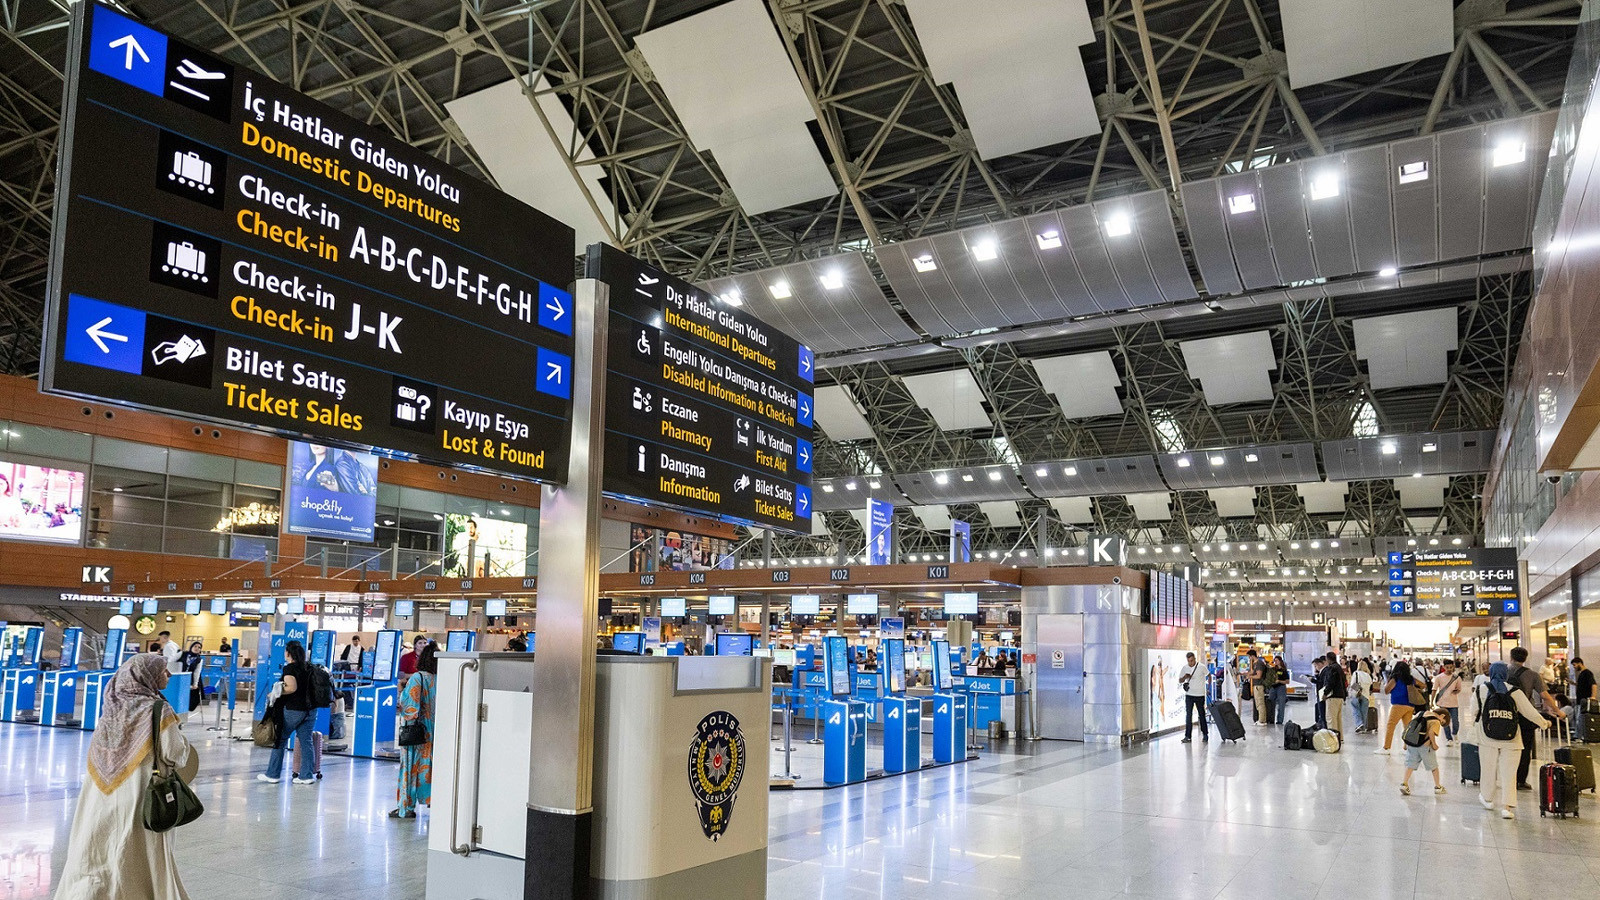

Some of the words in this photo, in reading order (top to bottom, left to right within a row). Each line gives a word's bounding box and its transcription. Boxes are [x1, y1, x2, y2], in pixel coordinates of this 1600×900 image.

[243, 80, 266, 122] İç
[273, 101, 344, 149] Hatlar
[351, 136, 409, 181] Giden
[413, 164, 461, 205] Yolcu
[241, 121, 352, 188] Domestic
[356, 170, 461, 233] Departures
[239, 173, 341, 231] Check-in
[236, 208, 339, 263] Check-in
[233, 260, 336, 312] Check-in
[350, 226, 533, 325] A-B-C-D-E-F-G-H
[231, 295, 334, 344] Check-in
[344, 303, 404, 355] J-K
[666, 285, 684, 310] Dış
[686, 295, 717, 322] Hatlar
[718, 311, 745, 335] Giden
[746, 324, 768, 347] Yolcu
[665, 308, 730, 349] International
[732, 338, 776, 371] Departures
[226, 345, 285, 382] Bilet
[291, 361, 348, 398] Satış
[663, 341, 698, 368] Engelli
[699, 354, 723, 378] Yolcu
[725, 368, 759, 393] Danışma
[760, 381, 768, 395] &
[768, 384, 797, 409] Check-in
[223, 382, 300, 420] Ticket
[305, 397, 363, 432] Sales
[663, 363, 706, 393] Disabled
[708, 377, 756, 411] Information
[758, 399, 764, 413] &
[765, 402, 795, 428] Check-in
[443, 398, 491, 434] Kayıp
[495, 411, 530, 440] Eşya
[662, 397, 699, 423] Eczane
[661, 420, 712, 451] Pharmacy
[756, 426, 767, 446] İlk
[767, 430, 793, 455] Yardım
[442, 429, 479, 456] Lost
[483, 440, 495, 459] &
[500, 442, 545, 470] Found
[756, 449, 773, 468] First
[774, 455, 787, 472] Aid
[660, 453, 706, 480] Danışma
[660, 476, 721, 504] Information
[755, 478, 773, 497] Bilet
[774, 484, 793, 504] Satış
[301, 496, 343, 515] shop&fly
[755, 498, 776, 517] Ticket
[776, 503, 794, 522] Sales
[1093, 537, 1114, 562] K
[82, 566, 92, 583] K
[94, 567, 111, 583] K
[523, 579, 535, 588] K07
[640, 574, 655, 585] K05
[690, 573, 705, 584] K04
[773, 571, 789, 582] K03
[831, 569, 848, 580] K02
[929, 566, 948, 578] K01
[1441, 569, 1514, 581] A-B-C-D-E-F-G-H
[60, 593, 120, 603] STARBUCKS
[1442, 587, 1456, 598] J-K
[1314, 613, 1323, 623] H
[287, 628, 305, 639] AJet
[811, 674, 825, 683] AJe
[970, 680, 991, 690] AJet
[701, 713, 736, 733] POLİS
[705, 792, 728, 803] GENEL
